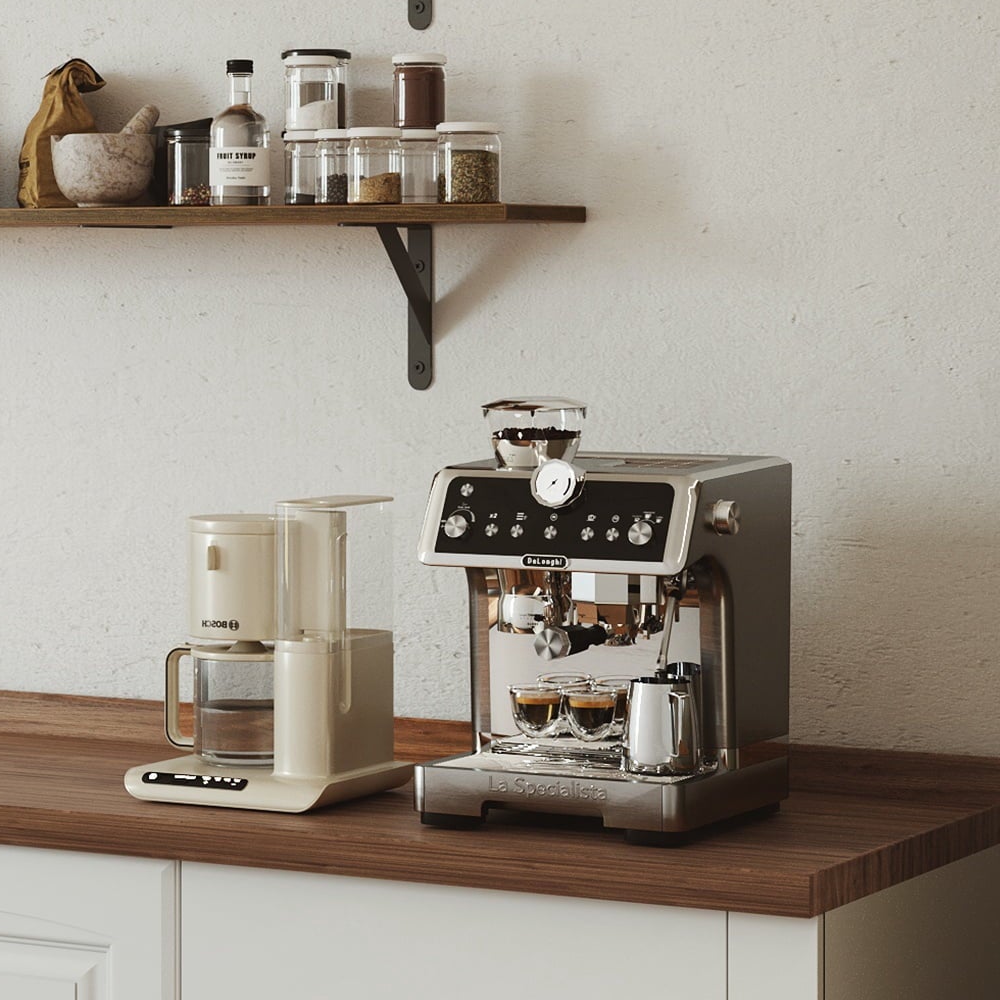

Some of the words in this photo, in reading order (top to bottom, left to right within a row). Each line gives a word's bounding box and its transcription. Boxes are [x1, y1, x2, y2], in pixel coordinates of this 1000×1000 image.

[235, 152, 256, 160] SYRUP
[488, 775, 509, 793] La
[513, 776, 608, 800] Specialista
